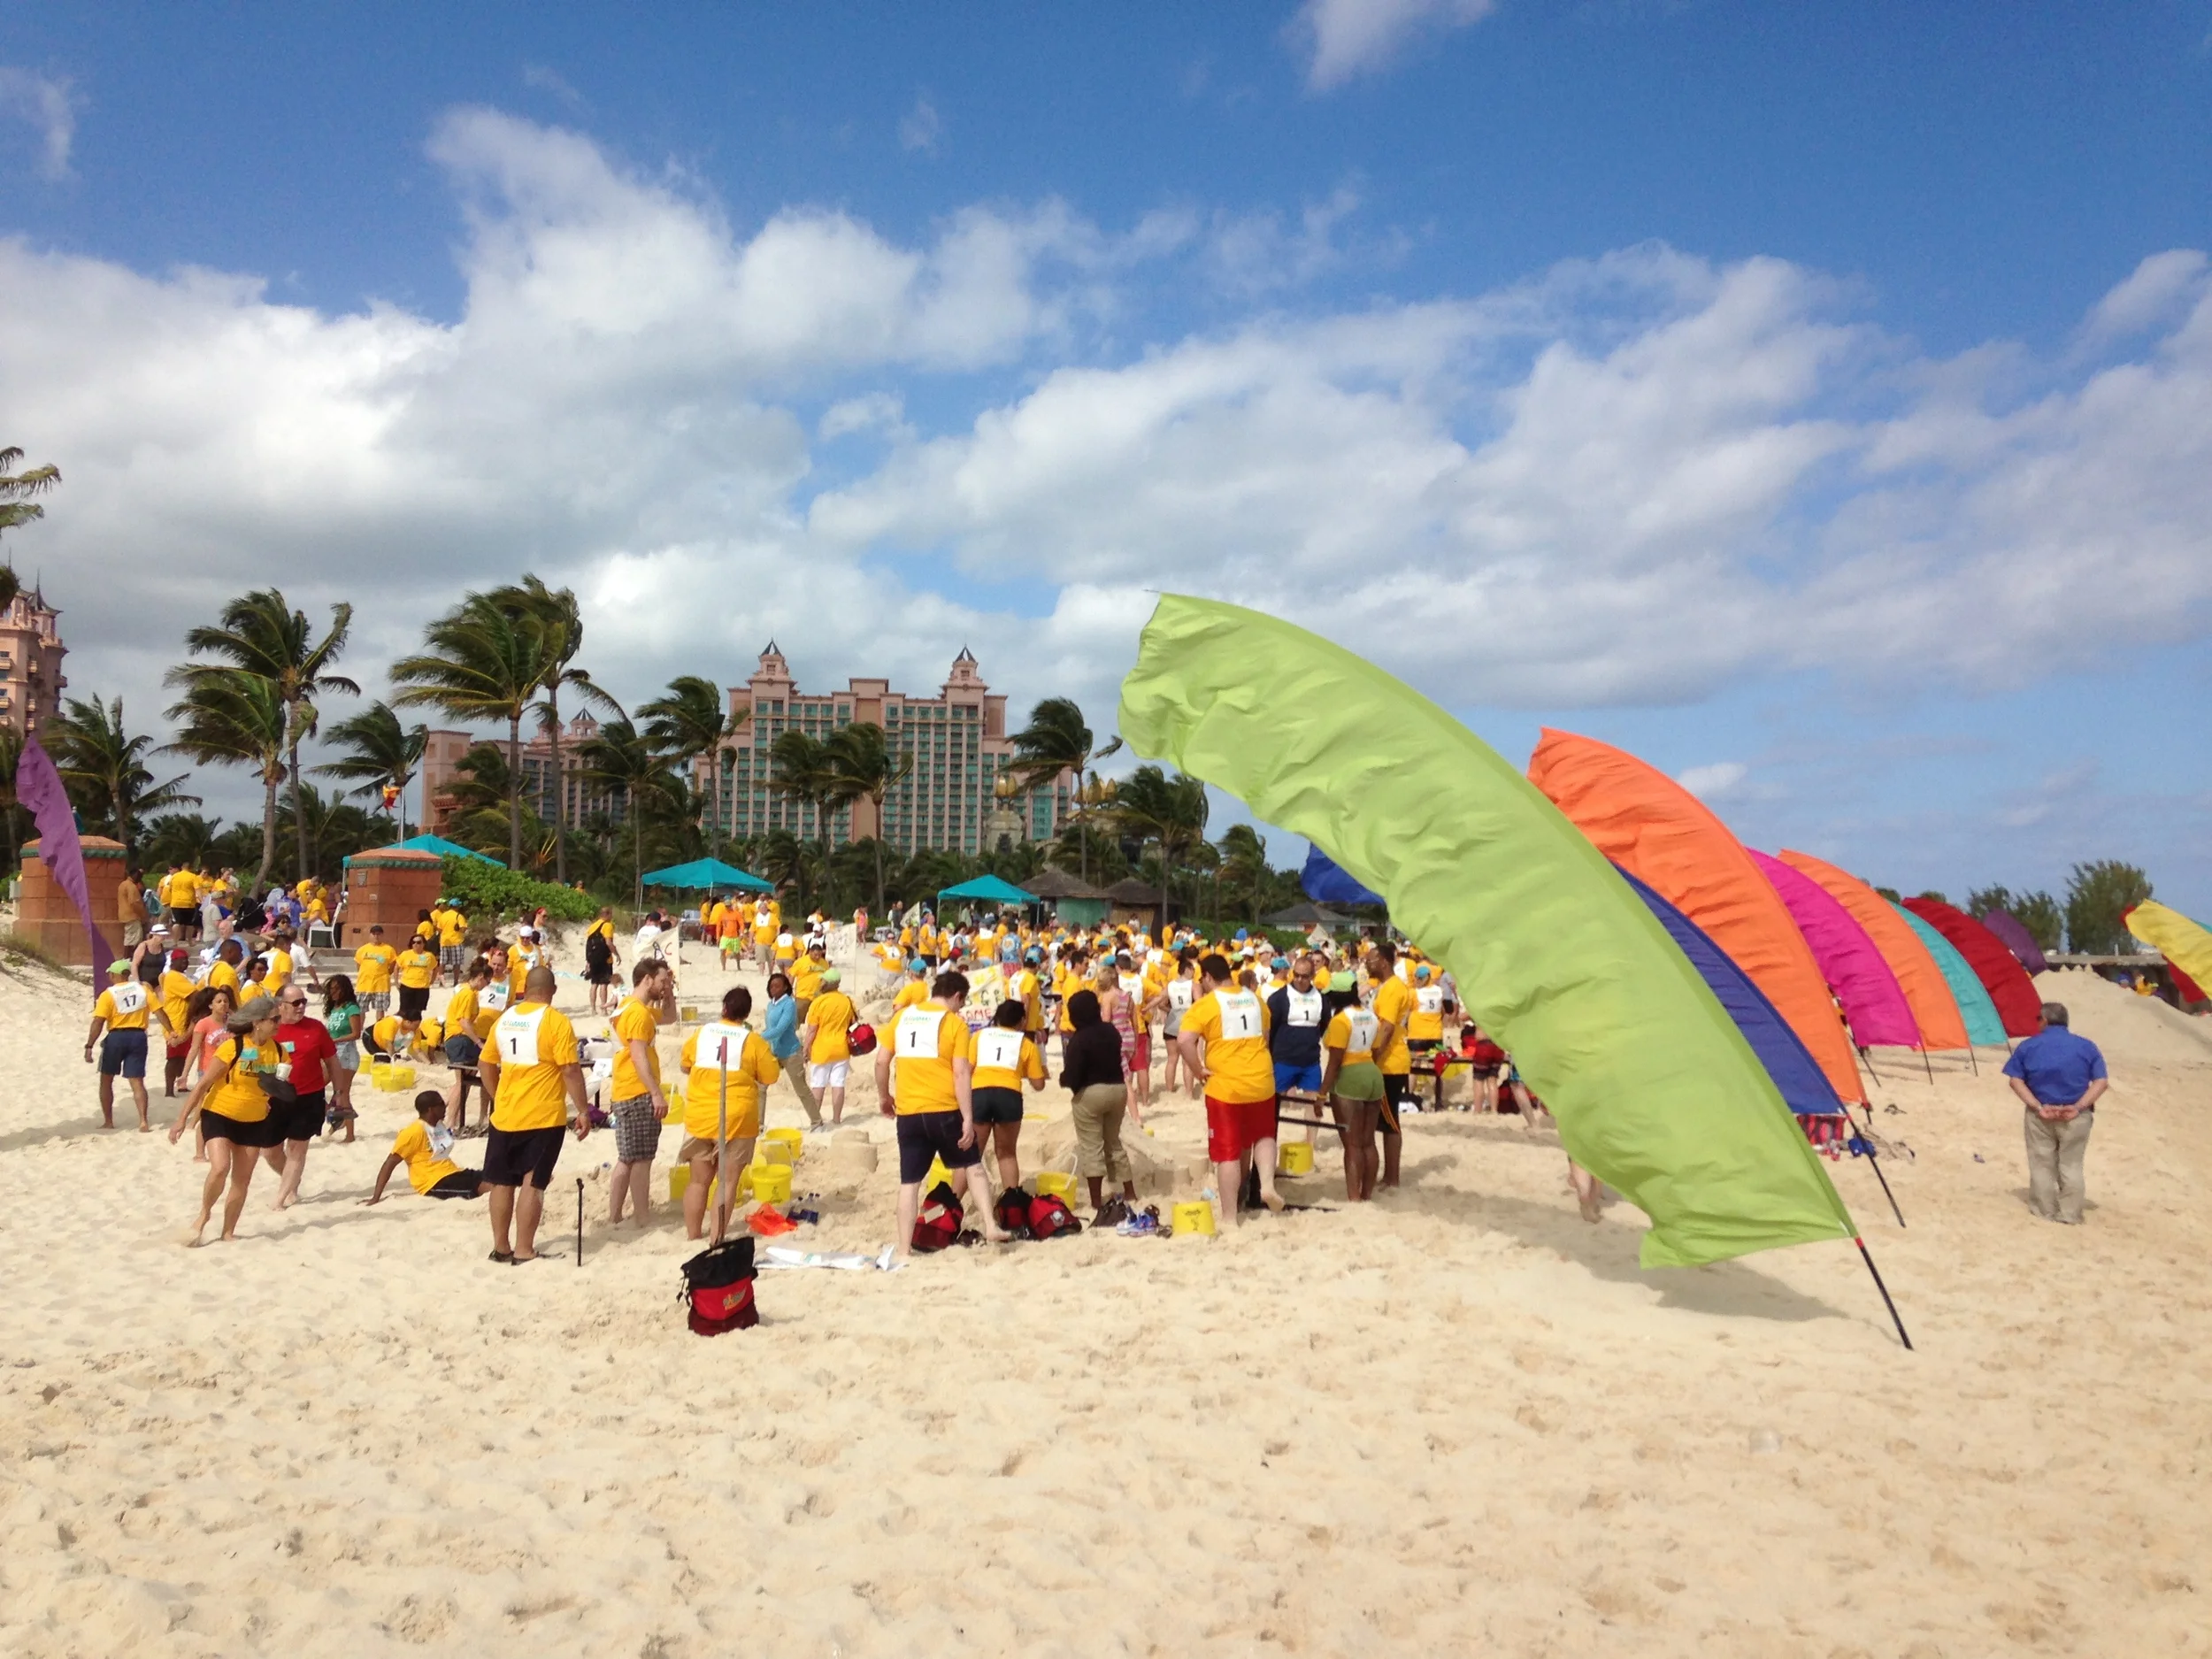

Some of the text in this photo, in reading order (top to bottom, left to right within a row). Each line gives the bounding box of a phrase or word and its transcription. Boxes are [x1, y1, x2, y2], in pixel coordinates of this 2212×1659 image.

[122, 994, 137, 1008] 17
[488, 993, 495, 1004] 2
[1428, 999, 1435, 1010] 5
[1240, 1013, 1248, 1031] 1
[1303, 1010, 1310, 1021] 1
[910, 1031, 917, 1048] 1
[1360, 1030, 1365, 1046] 1
[510, 1037, 517, 1055] 1
[995, 1047, 1002, 1062] 1
